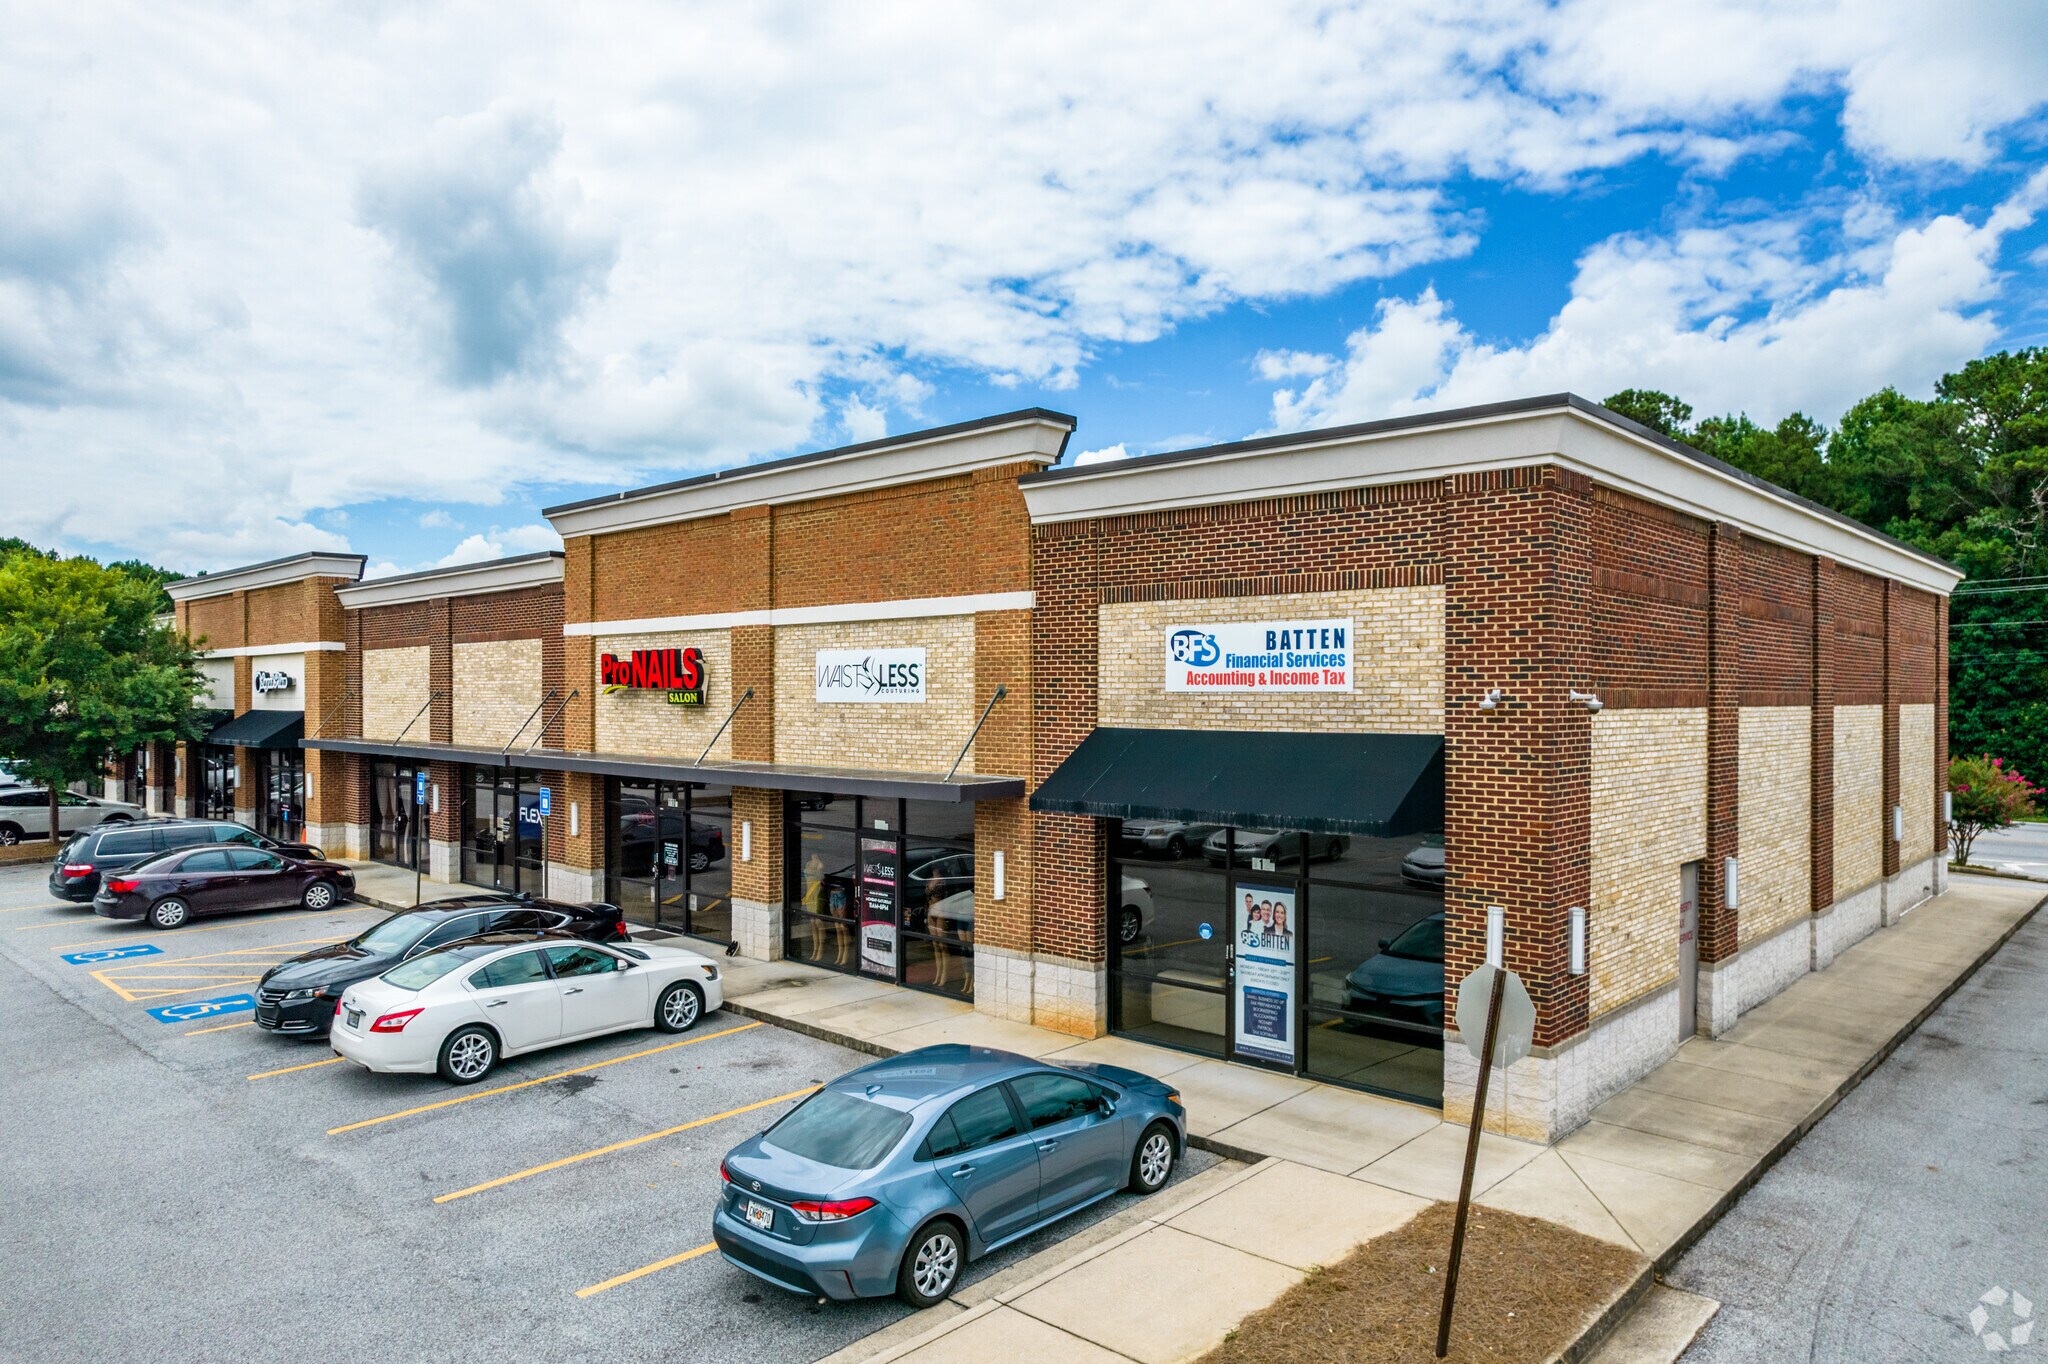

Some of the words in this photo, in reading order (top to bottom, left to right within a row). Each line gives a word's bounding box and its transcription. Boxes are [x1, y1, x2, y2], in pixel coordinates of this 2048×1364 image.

[1173, 632, 1217, 663] BFS
[1266, 628, 1345, 650] BATTEN
[601, 653, 630, 684] Pro
[632, 648, 699, 689] NAILS
[1225, 653, 1283, 668] Financial
[1286, 652, 1345, 667] Services
[818, 664, 862, 688] WAIST
[880, 663, 919, 688] LESS
[1186, 671, 1255, 687] Accounting
[1258, 672, 1267, 685] &
[1270, 670, 1319, 685] Income
[1322, 669, 1345, 685] Tax
[669, 692, 698, 703] SALON
[1261, 933, 1290, 951] BATTEN
[1252, 1007, 1278, 1015] BOOKKEEPING
[1257, 1001, 1281, 1010] PREPARATION
[1253, 1013, 1278, 1021] ACCOUNTING
